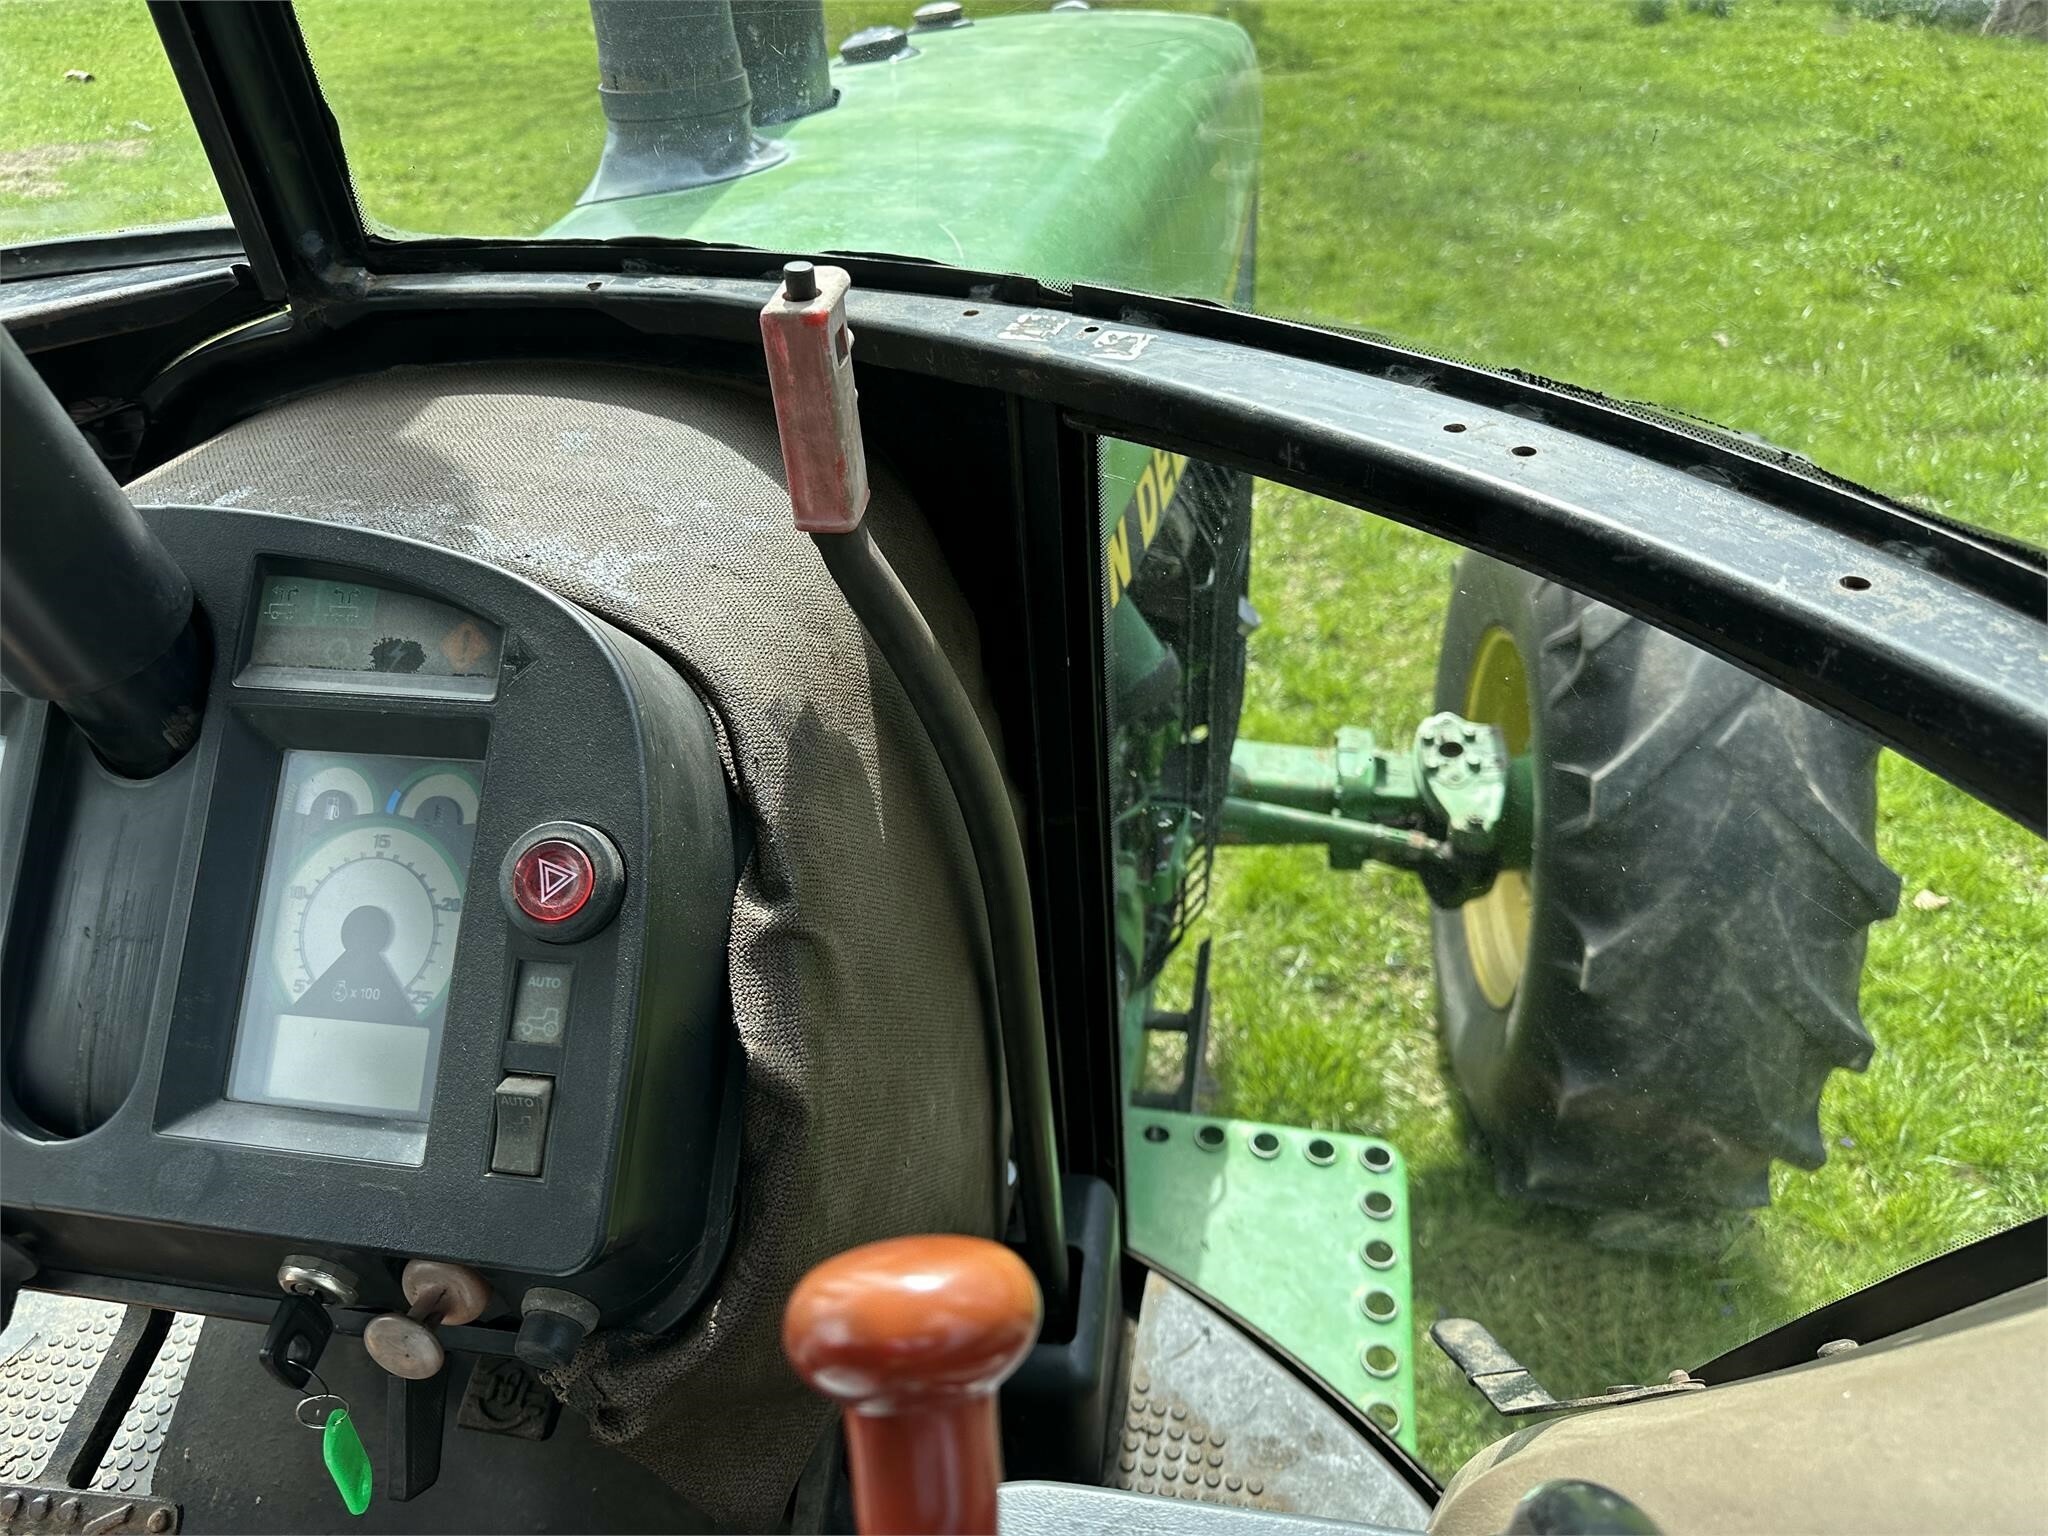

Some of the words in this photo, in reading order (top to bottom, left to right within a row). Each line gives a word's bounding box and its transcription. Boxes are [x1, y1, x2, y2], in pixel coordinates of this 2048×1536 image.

[373, 834, 392, 849] 15
[293, 979, 304, 993] 5
[527, 976, 561, 989] AUTO
[361, 987, 381, 1001] 100
[501, 1096, 534, 1109] AUTO
